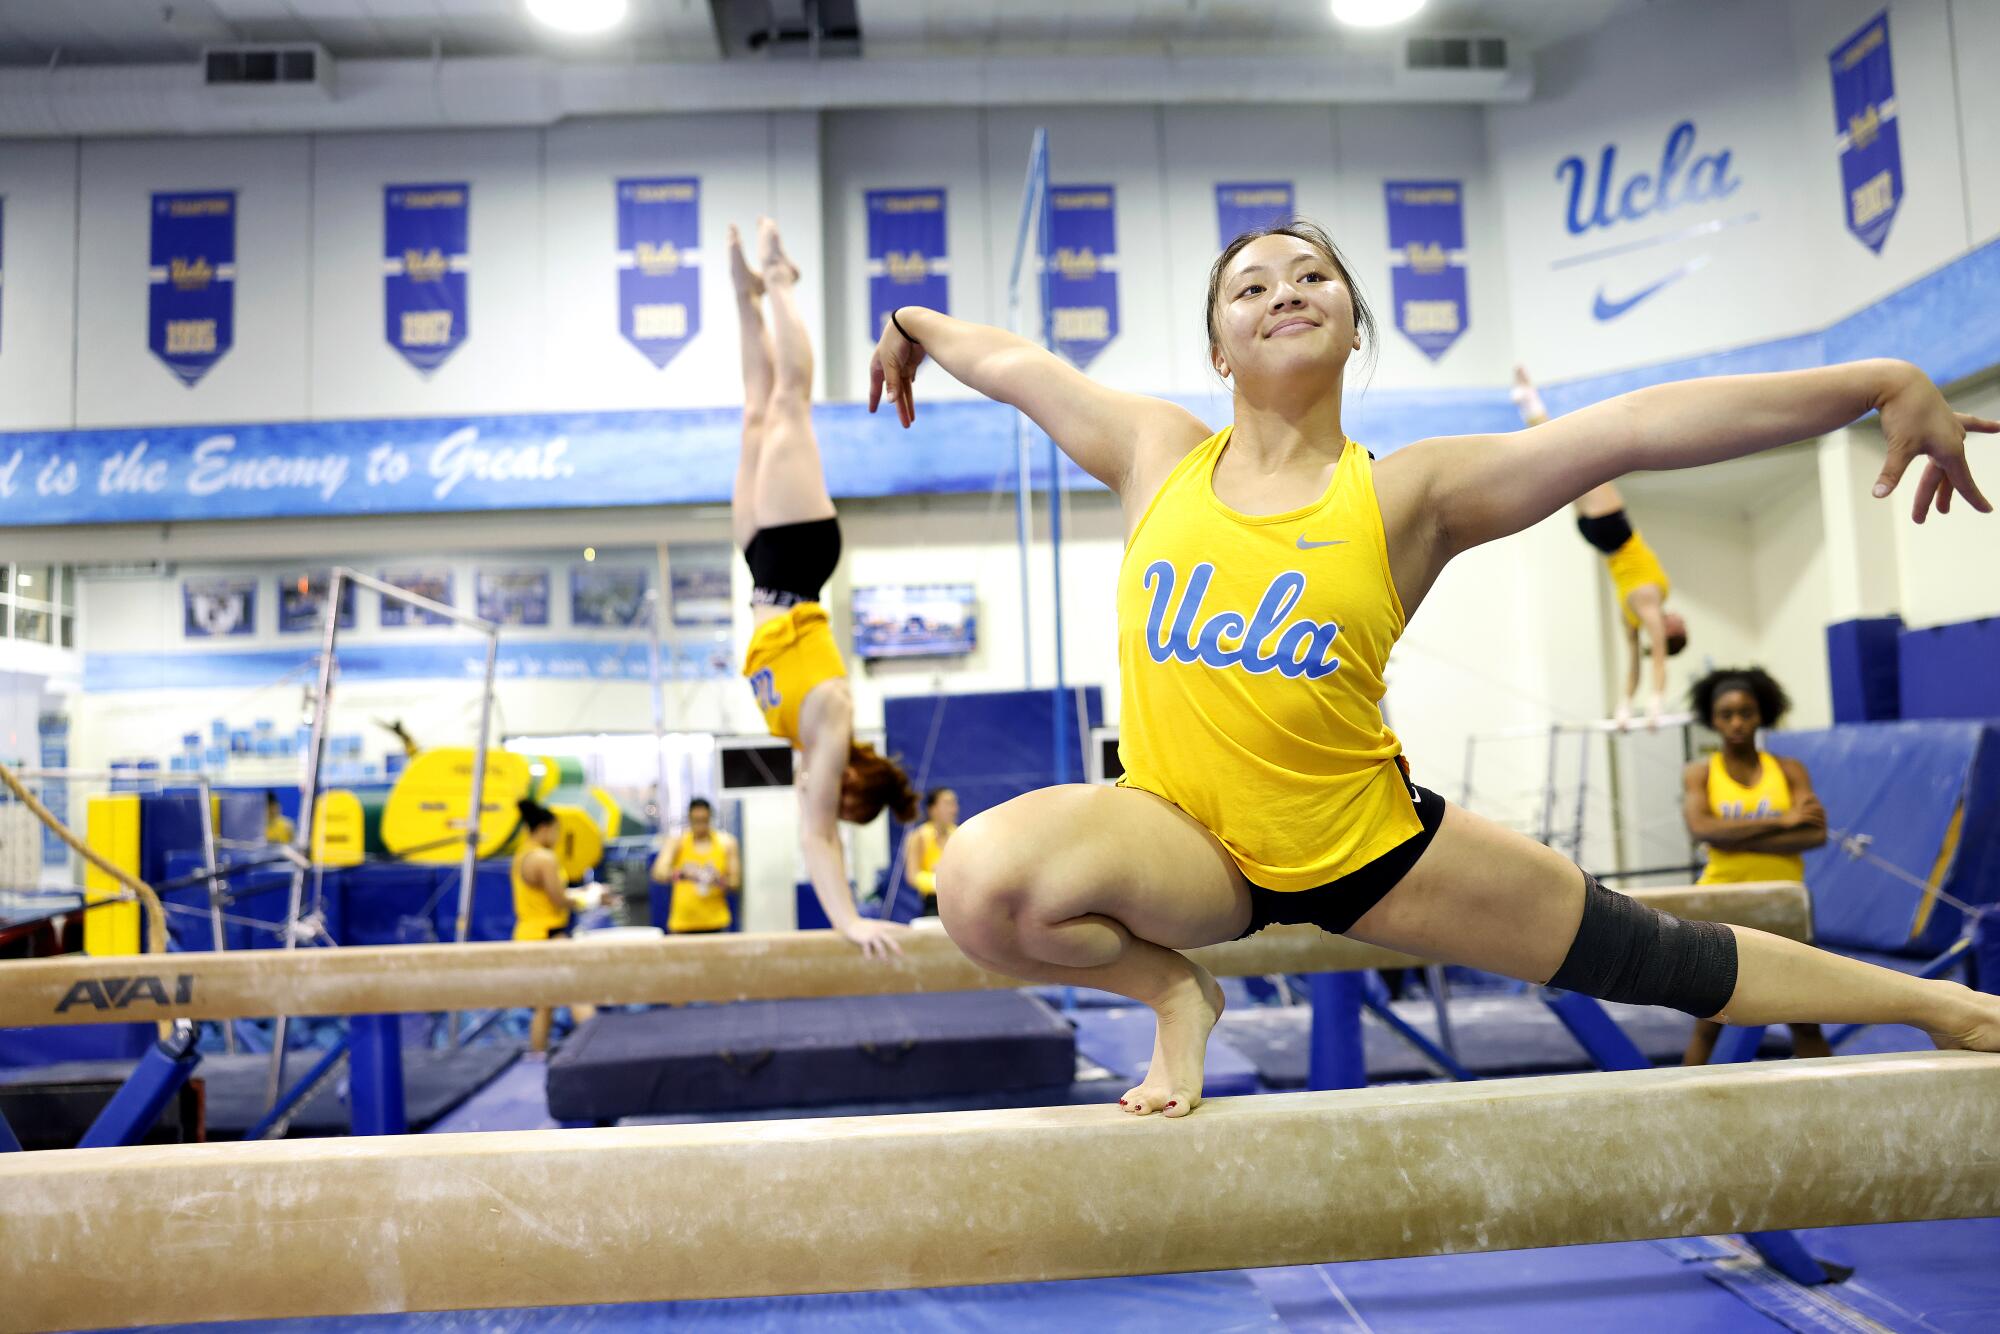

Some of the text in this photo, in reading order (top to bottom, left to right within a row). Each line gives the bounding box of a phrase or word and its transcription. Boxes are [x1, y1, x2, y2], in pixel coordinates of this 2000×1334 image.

[1554, 119, 1742, 235] Ucla
[36, 454, 78, 496] is
[98, 439, 169, 496] the
[187, 434, 350, 501] Enemy
[366, 442, 410, 487] to
[428, 425, 575, 500] Great.
[1143, 560, 1340, 680] Ucla
